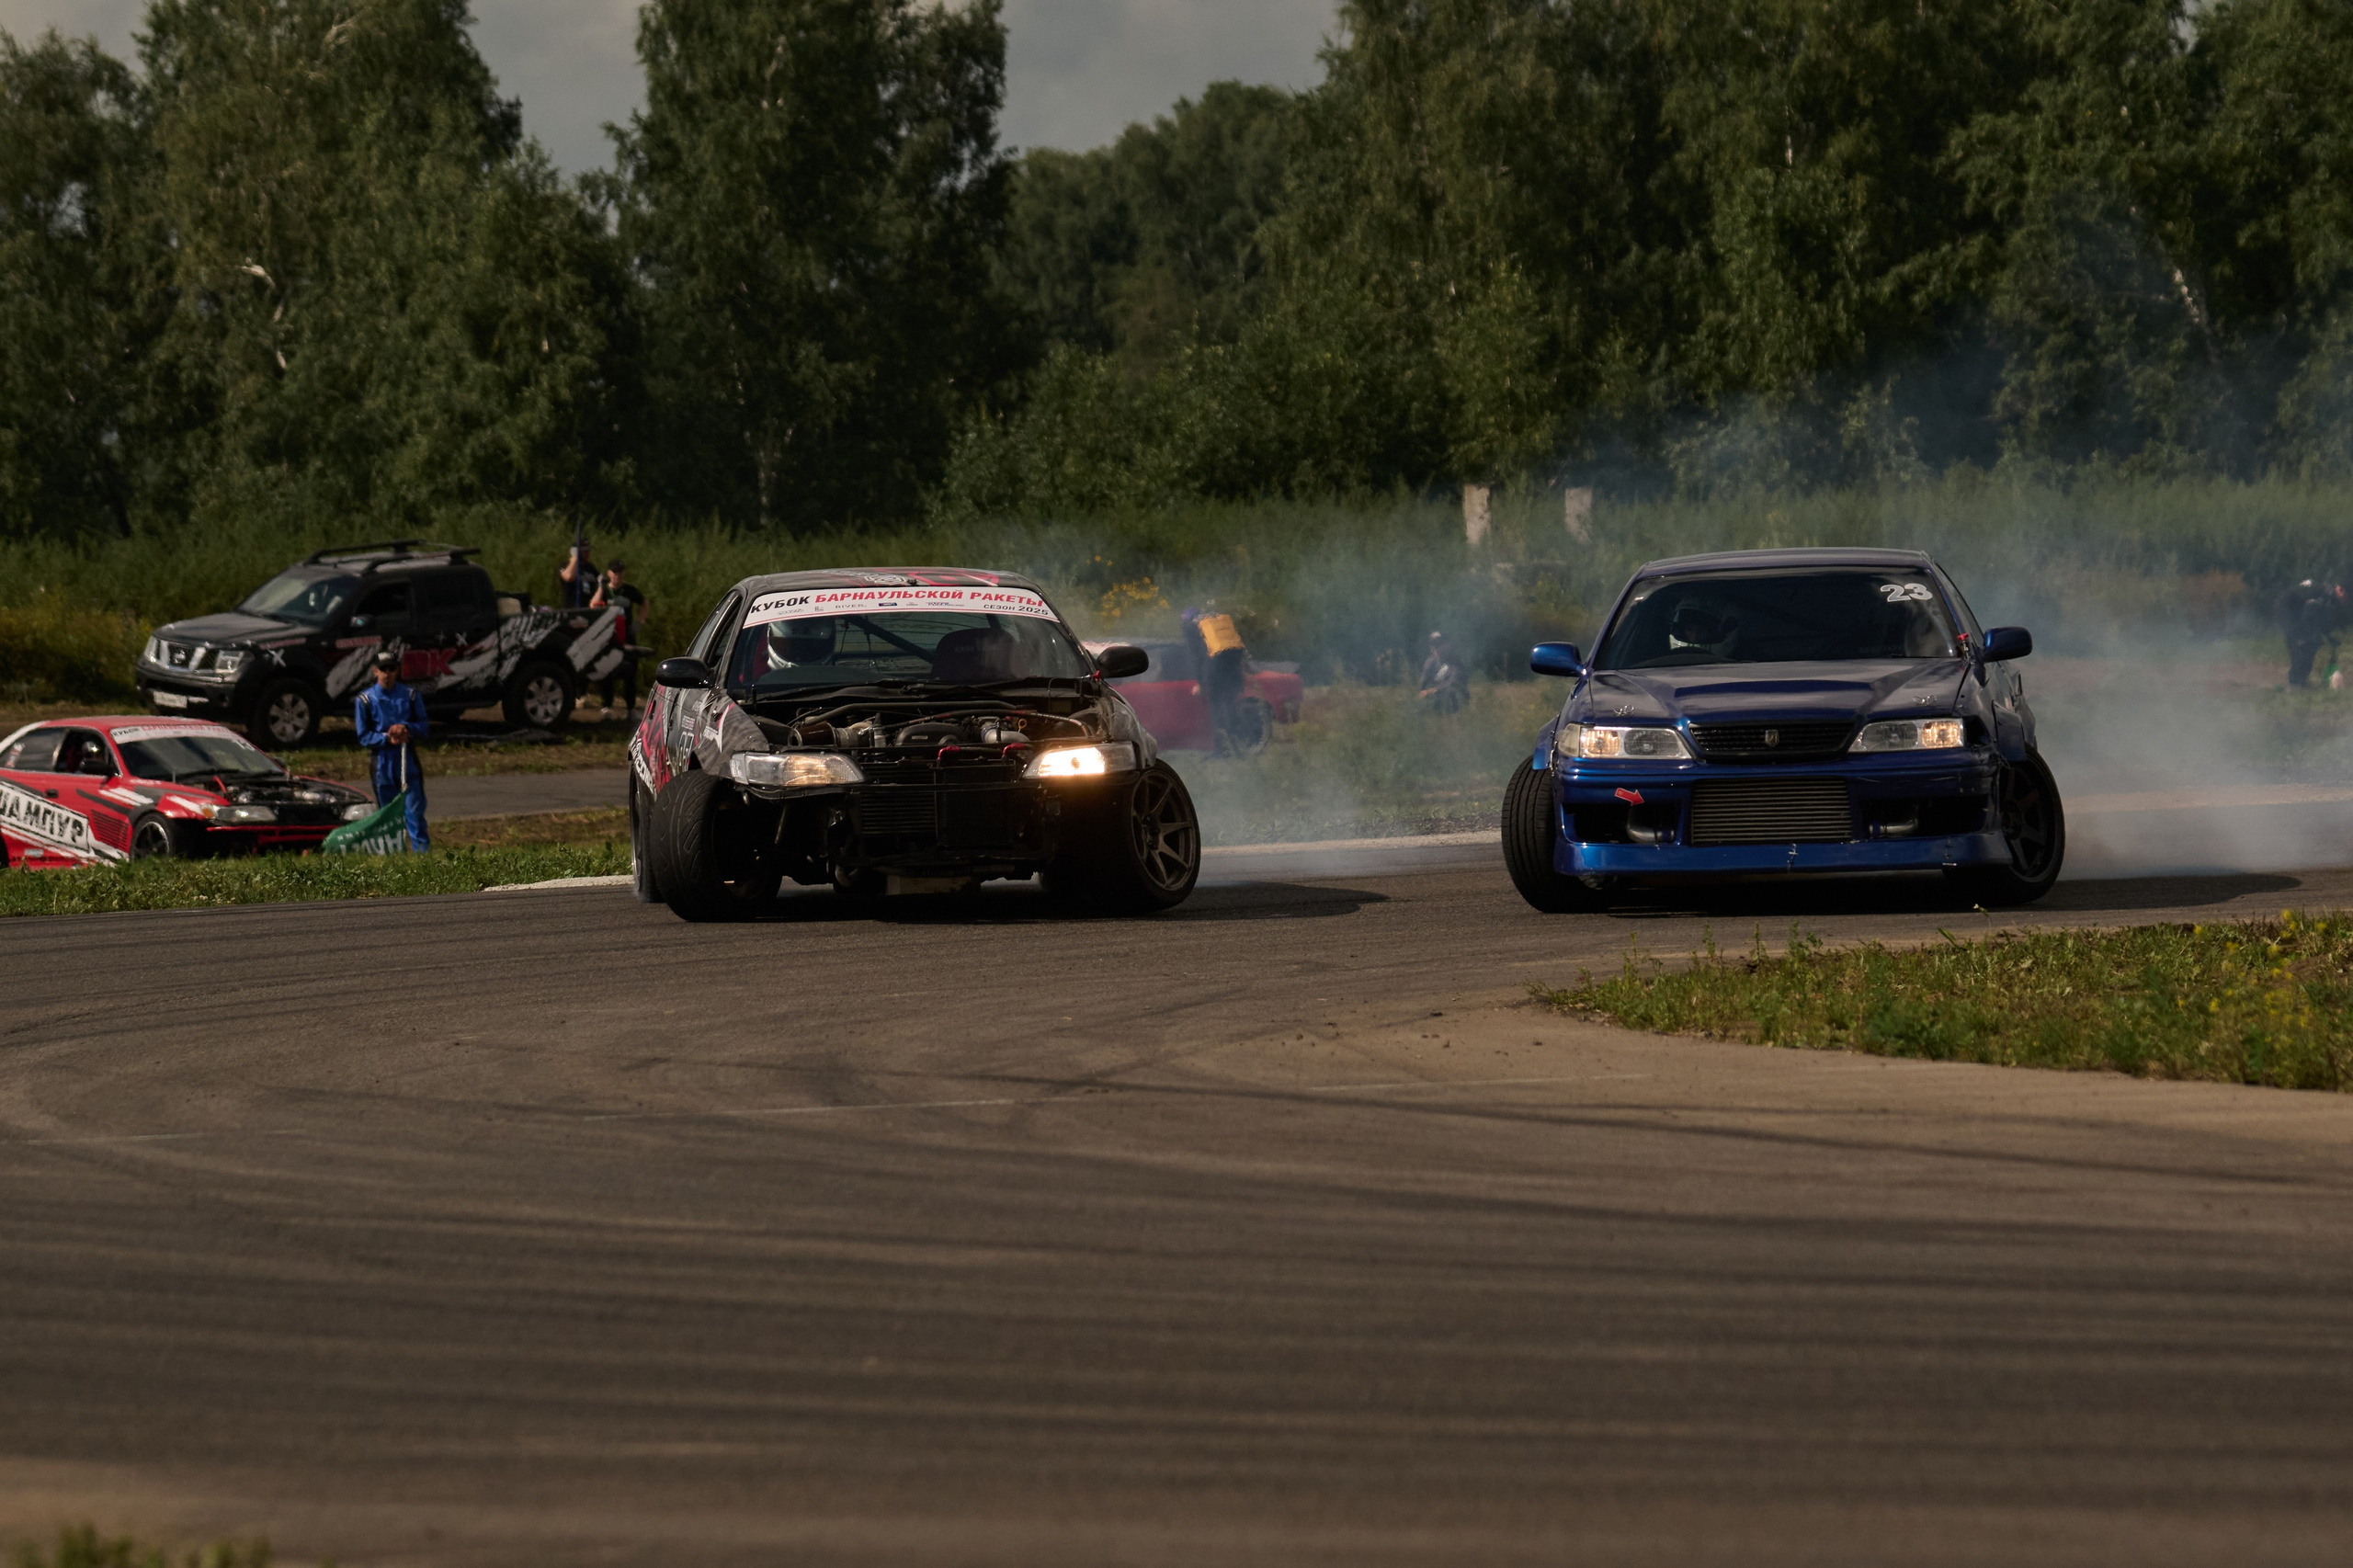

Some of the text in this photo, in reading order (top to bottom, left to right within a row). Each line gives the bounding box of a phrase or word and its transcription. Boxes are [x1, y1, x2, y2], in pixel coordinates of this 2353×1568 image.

[750, 596, 811, 614] КУБОК
[815, 589, 963, 603] БАРНАУЛЬСКОЙ
[970, 592, 1043, 607] РАКЕТЫ
[1880, 583, 1933, 602] 23
[1018, 606, 1049, 616] 2025
